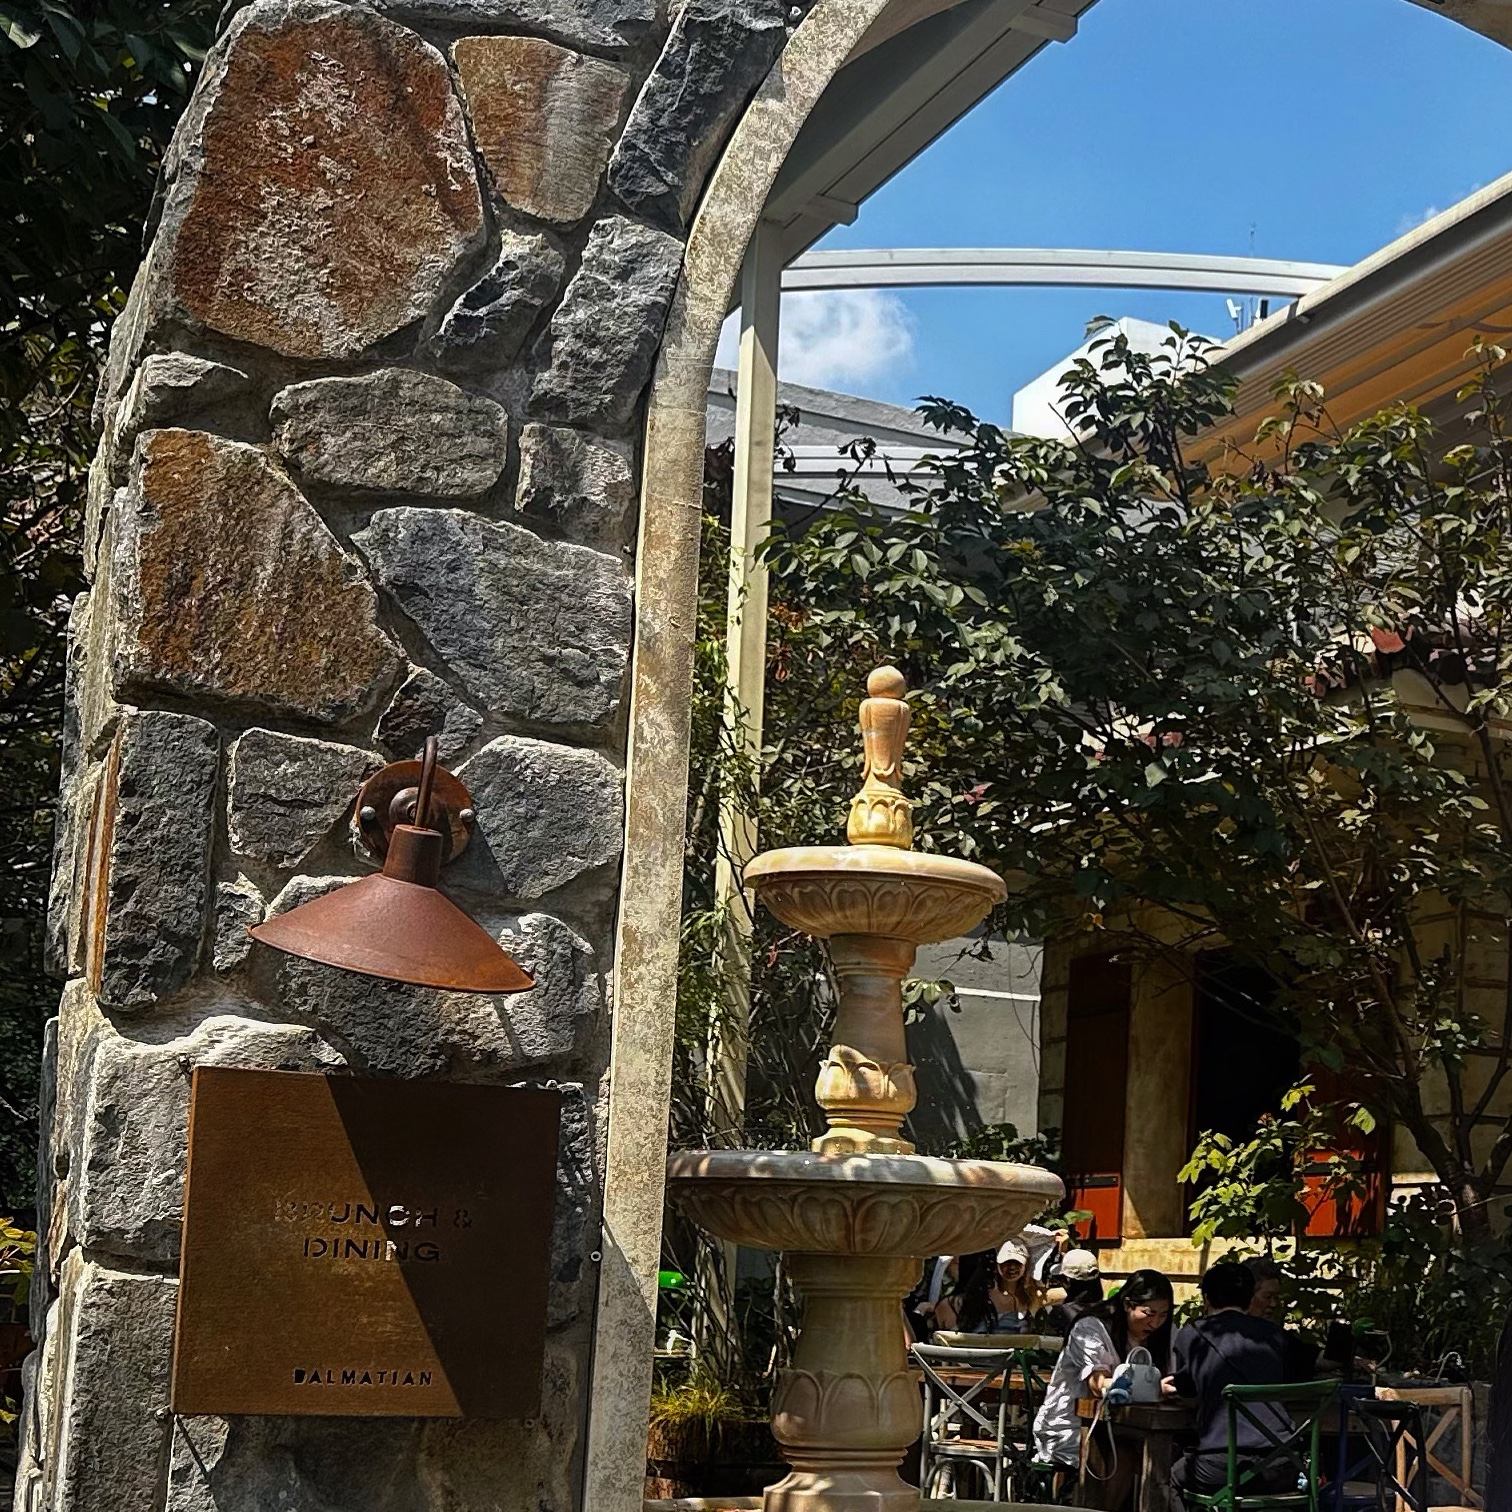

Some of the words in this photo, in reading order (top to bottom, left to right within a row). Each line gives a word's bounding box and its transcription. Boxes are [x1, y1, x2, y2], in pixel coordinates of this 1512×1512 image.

[453, 1207, 473, 1229] &
[303, 1236, 440, 1262] DINING
[294, 1368, 432, 1386] DALMATIAN
